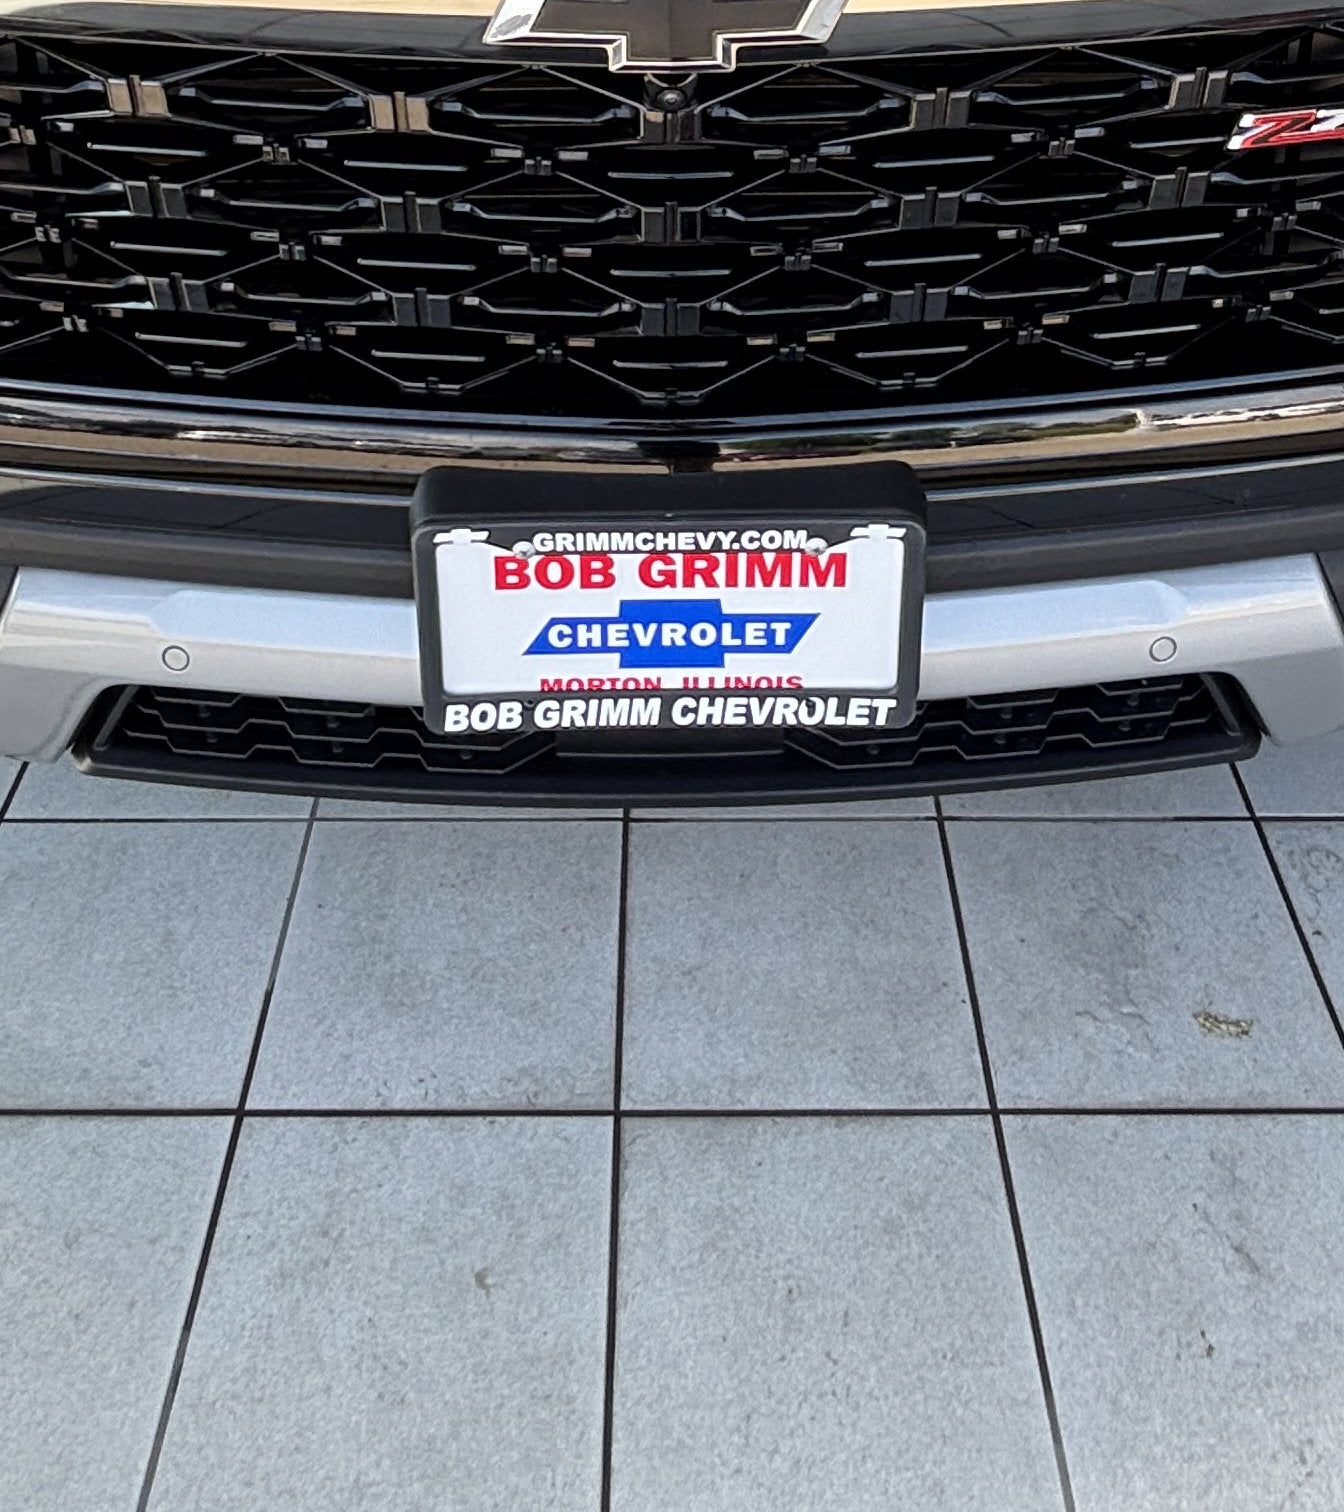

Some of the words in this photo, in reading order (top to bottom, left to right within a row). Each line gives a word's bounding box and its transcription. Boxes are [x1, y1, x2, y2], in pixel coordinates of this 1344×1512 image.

[532, 529, 808, 553] GRIMMCHEVY.COM
[493, 554, 616, 590] BOB
[638, 552, 847, 589] GRIMM
[547, 621, 793, 648] CHEVROLET
[444, 701, 523, 732] BOB
[533, 698, 660, 730] GRIMM
[671, 696, 897, 728] CHEVROLET
